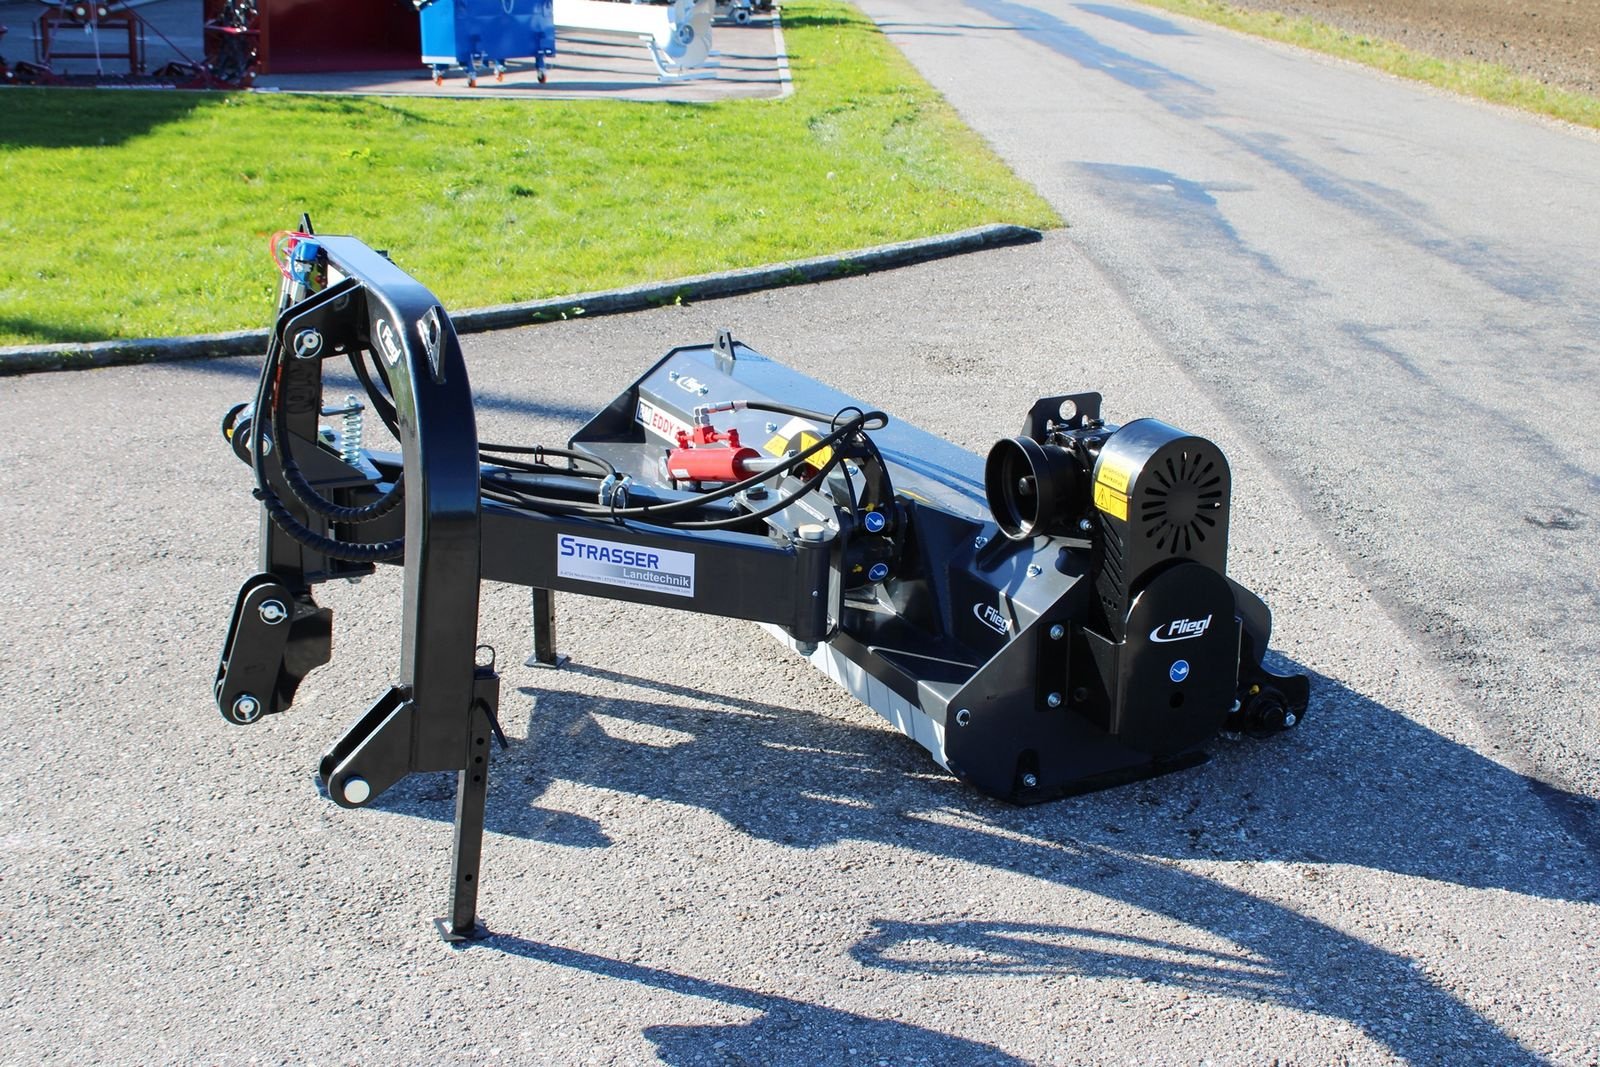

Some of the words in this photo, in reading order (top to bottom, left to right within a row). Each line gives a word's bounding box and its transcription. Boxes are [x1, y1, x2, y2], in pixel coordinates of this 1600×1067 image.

[652, 413, 675, 436] EDDY
[561, 537, 659, 569] STRASSER
[623, 568, 689, 587] Landtechnik
[984, 605, 1013, 633] Fliegl
[1168, 614, 1212, 635] Fliegl
